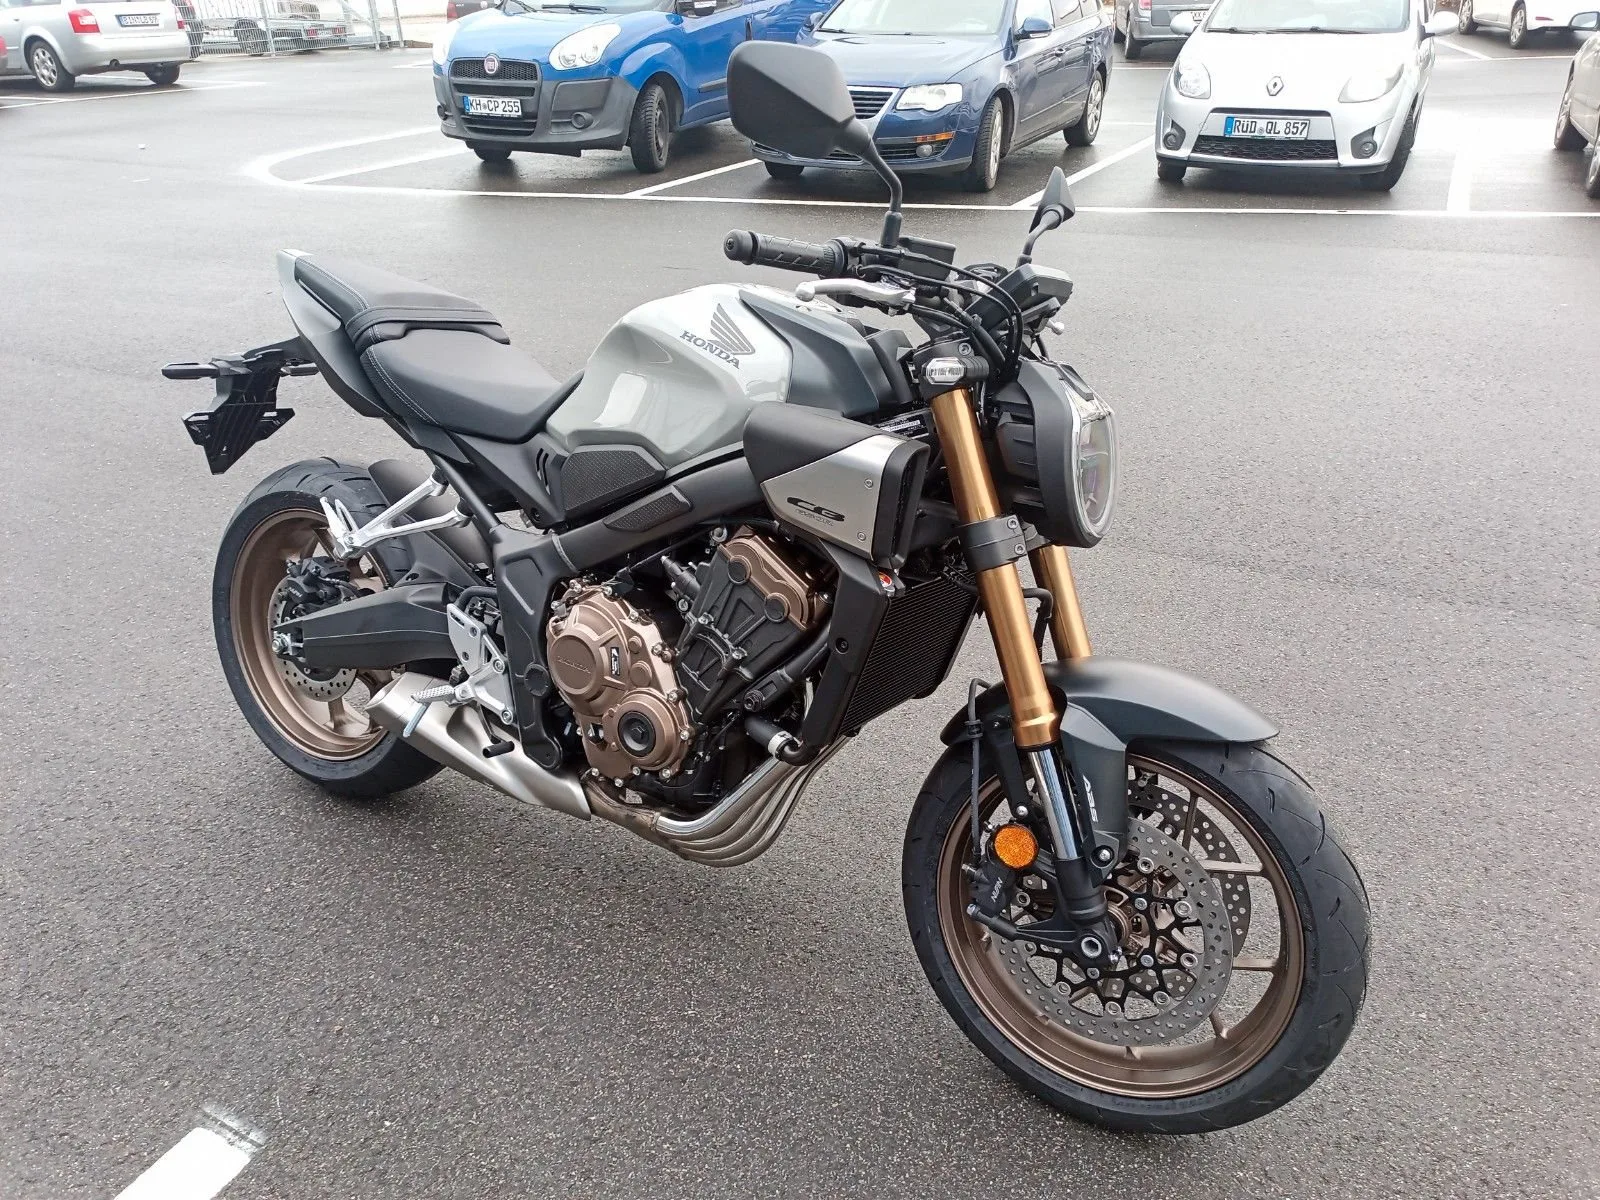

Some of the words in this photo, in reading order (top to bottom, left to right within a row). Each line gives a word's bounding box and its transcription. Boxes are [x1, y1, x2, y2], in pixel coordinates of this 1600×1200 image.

[470, 99, 482, 111] KH
[487, 99, 500, 112] CP
[501, 100, 520, 113] 255
[1233, 120, 1257, 134] RÜD
[1265, 121, 1281, 135] QL
[1283, 122, 1308, 136] 857
[680, 330, 740, 370] HONDA
[787, 496, 845, 522] CB
[1082, 773, 1099, 823] ABS
